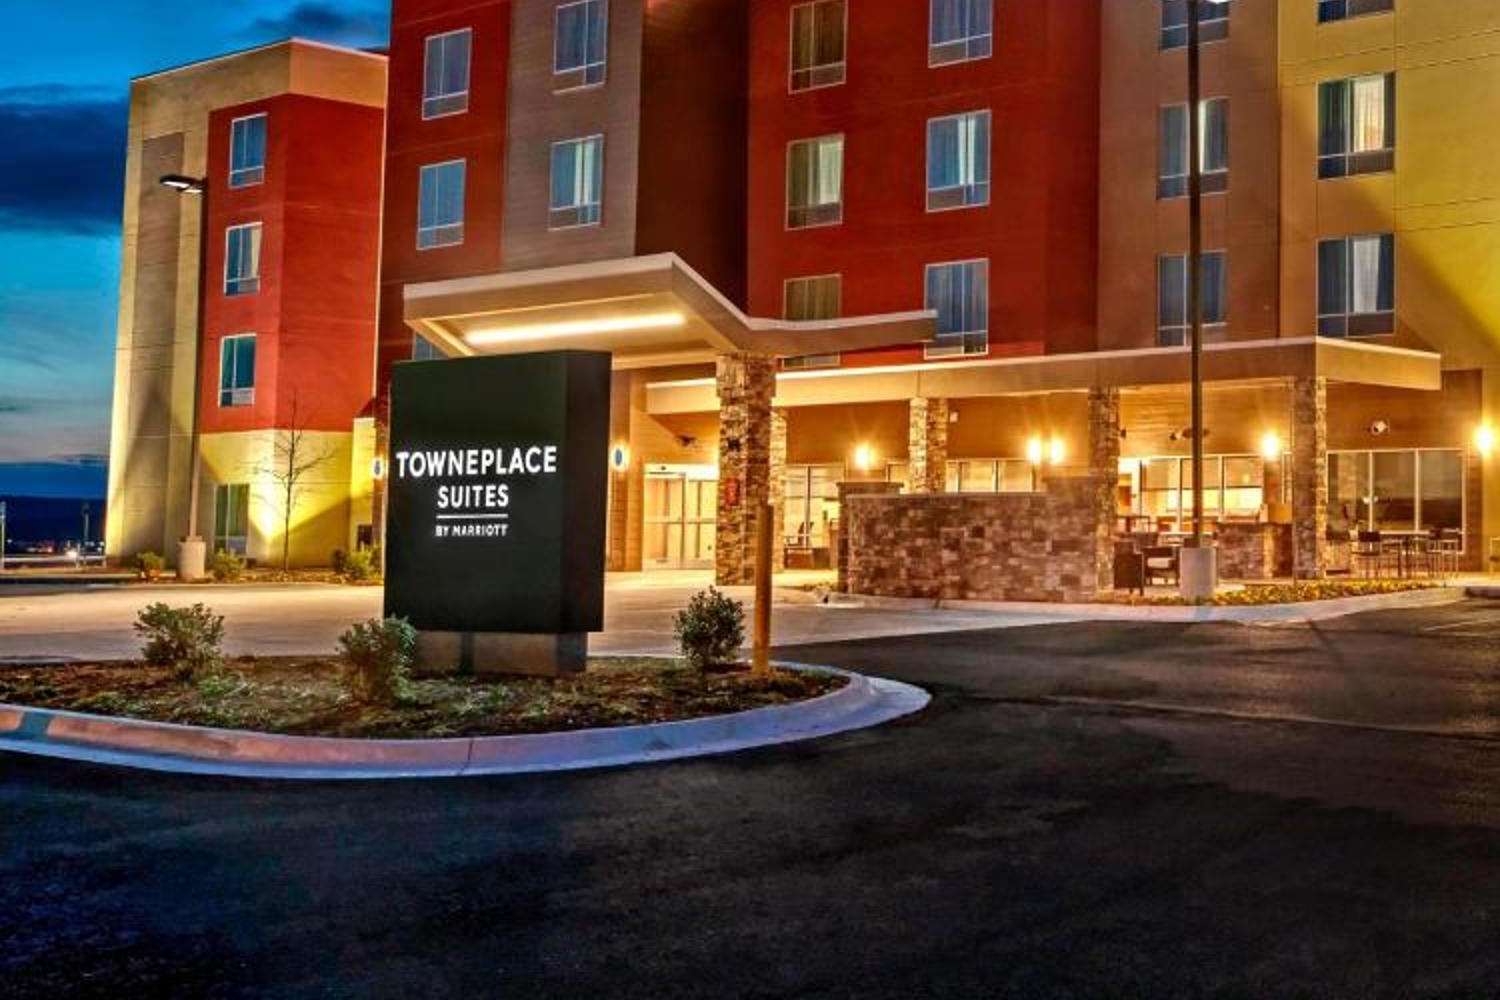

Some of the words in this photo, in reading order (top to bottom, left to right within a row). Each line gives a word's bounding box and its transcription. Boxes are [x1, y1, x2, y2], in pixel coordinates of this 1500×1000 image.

[396, 445, 558, 477] TOWNEPLACE
[437, 484, 510, 509] SUITES
[435, 525, 450, 537] BY
[451, 523, 509, 537] MARRIOTT
